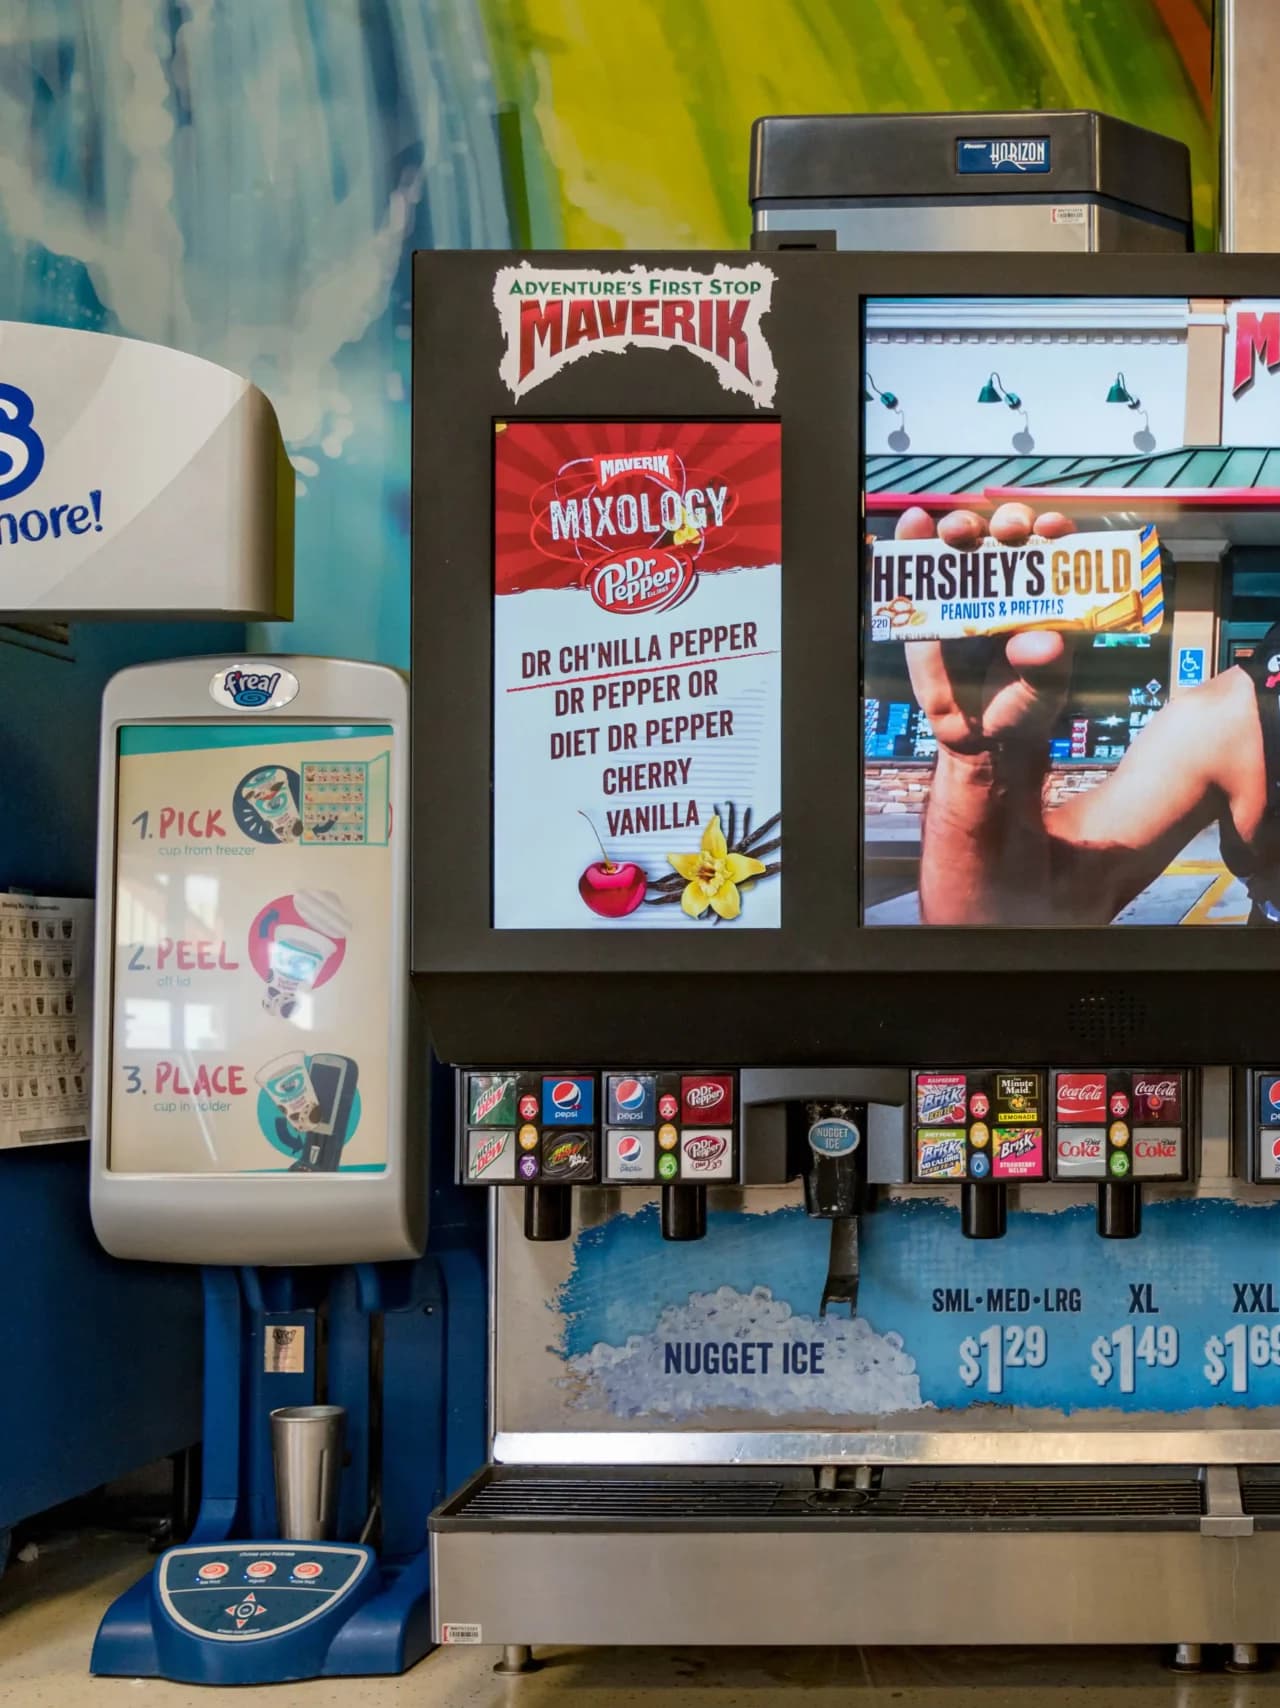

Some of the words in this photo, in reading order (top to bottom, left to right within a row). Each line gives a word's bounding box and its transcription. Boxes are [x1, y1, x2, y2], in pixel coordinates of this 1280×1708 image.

[990, 142, 1046, 162] HORIZON
[509, 279, 642, 296] ADVENTURE'S
[650, 279, 703, 295] FIRST
[710, 279, 762, 295] STOP
[518, 300, 753, 385] MAVERIK
[600, 455, 670, 487] MAVERIK
[550, 487, 728, 540] MIXOLOGY
[600, 563, 676, 605] Pepper
[625, 557, 656, 582] Dr
[873, 550, 1045, 602] HERSHEY'S
[1052, 549, 1131, 596] GOLD
[941, 603, 995, 621] PEANUTS
[999, 603, 1007, 616] &
[522, 649, 551, 679] DR
[559, 635, 661, 674] CH'NILLA
[670, 621, 757, 659] PEPPER
[555, 687, 584, 716] DR
[593, 674, 680, 711] PEPPER
[688, 669, 718, 697] OR
[550, 727, 600, 759] DIET
[608, 723, 637, 752] DR
[646, 709, 734, 747] PEPPER
[603, 757, 692, 795] CHERRY
[132, 810, 153, 840] 1.
[160, 807, 226, 839] PICK
[607, 800, 699, 837] VANILLA
[159, 847, 181, 857] cup
[184, 845, 212, 856] from
[216, 845, 256, 856] freezer
[157, 937, 239, 970] PEEL
[122, 1065, 146, 1095] 3.
[155, 1061, 248, 1097] PLACE
[1001, 1080, 1033, 1088] Minute
[1006, 1087, 1029, 1095] Maid
[154, 1102, 176, 1112] cup
[180, 1102, 190, 1112] in
[617, 1112, 643, 1121] pepsi
[825, 1138, 840, 1149] ICE
[1058, 1141, 1100, 1157] Coke
[1135, 1141, 1176, 1158] Coke
[1129, 1283, 1159, 1313] XL
[1232, 1283, 1280, 1313] XXL
[664, 1342, 773, 1375] NUGGET
[783, 1342, 825, 1374] ICE
